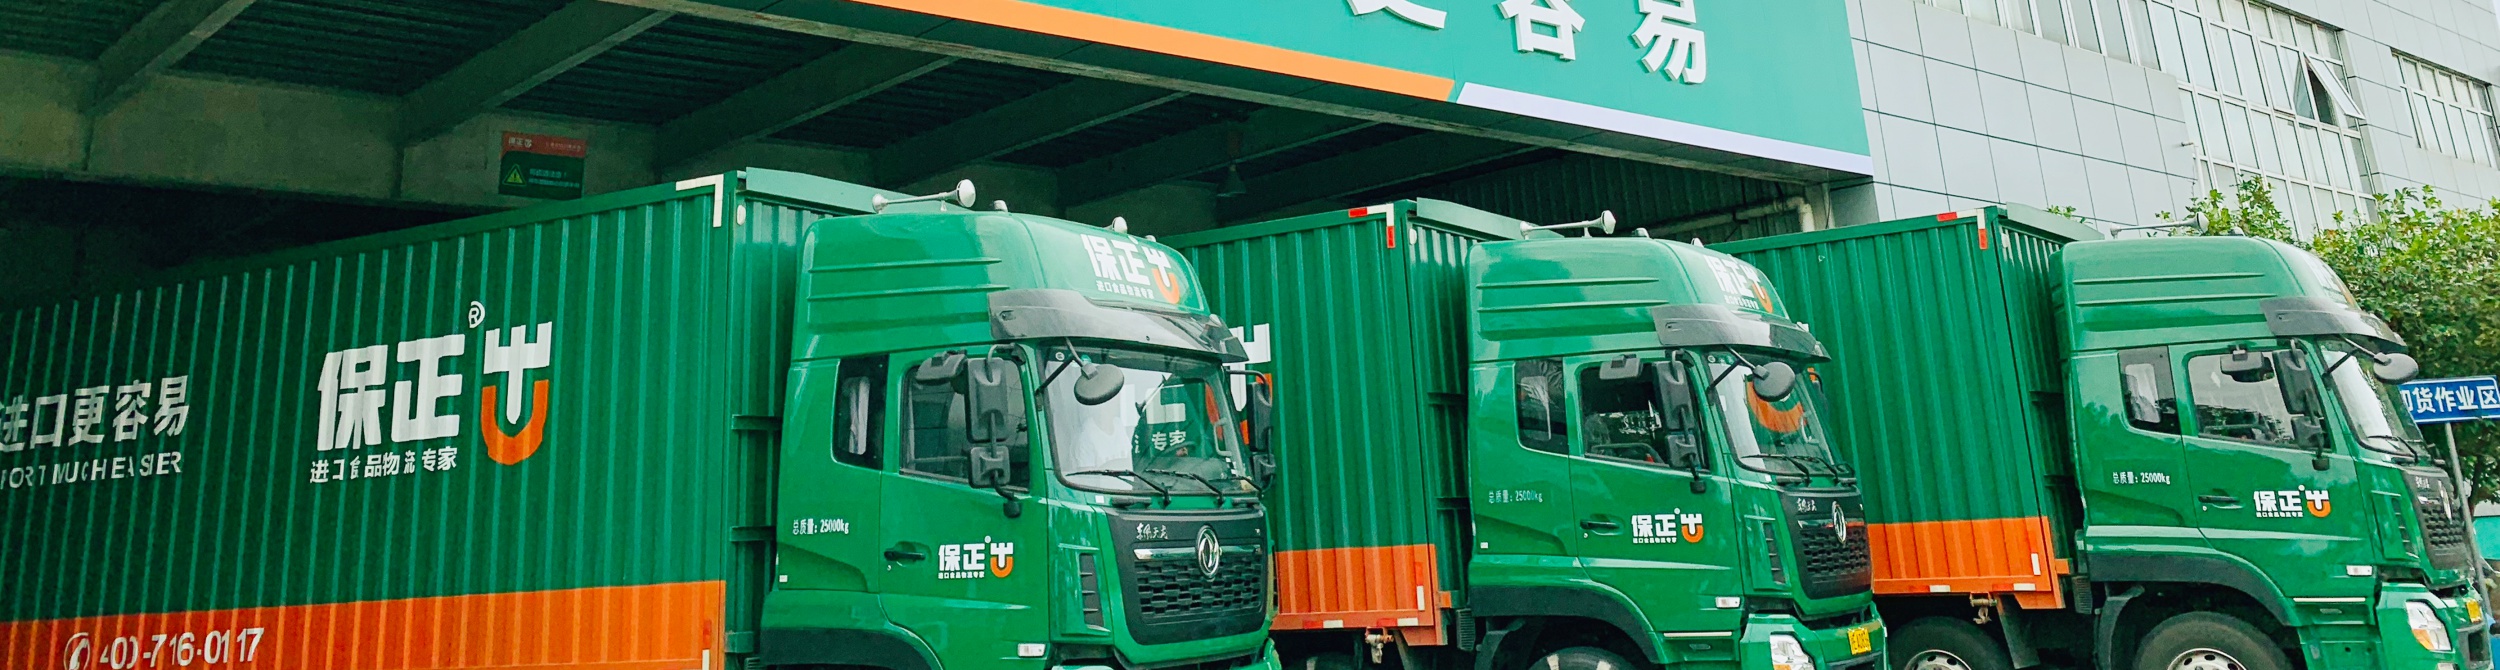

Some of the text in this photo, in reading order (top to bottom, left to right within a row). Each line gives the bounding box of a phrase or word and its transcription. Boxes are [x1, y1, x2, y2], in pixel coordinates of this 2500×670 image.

[1081, 234, 1151, 285] 保正
[317, 333, 466, 451] 保正
[2253, 490, 2302, 512] 保正
[1631, 514, 1677, 537] 保正
[938, 543, 985, 571] 保正
[100, 627, 265, 669] 400-716-0117
